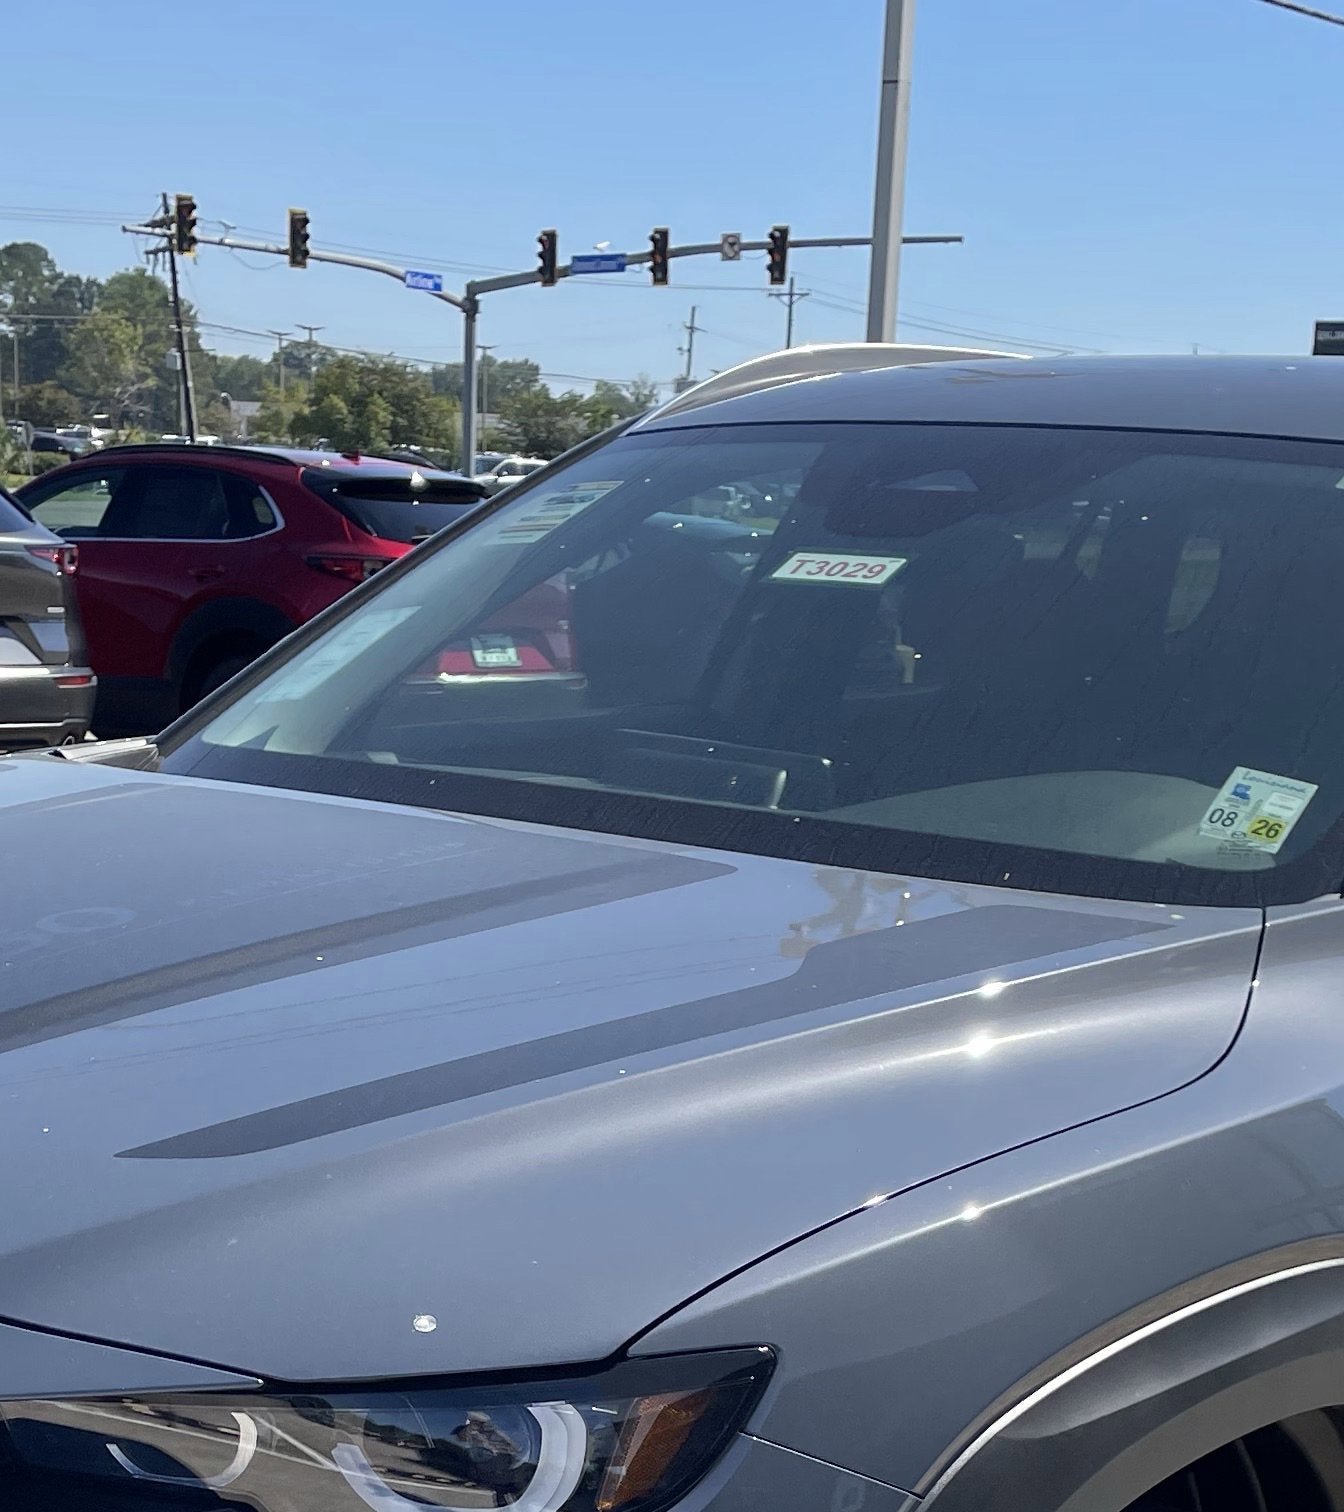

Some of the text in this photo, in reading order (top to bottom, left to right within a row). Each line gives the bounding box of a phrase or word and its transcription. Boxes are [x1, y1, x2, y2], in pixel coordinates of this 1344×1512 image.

[789, 558, 887, 579] T3029
[1208, 808, 1238, 828] 08
[1250, 819, 1283, 839] 26
